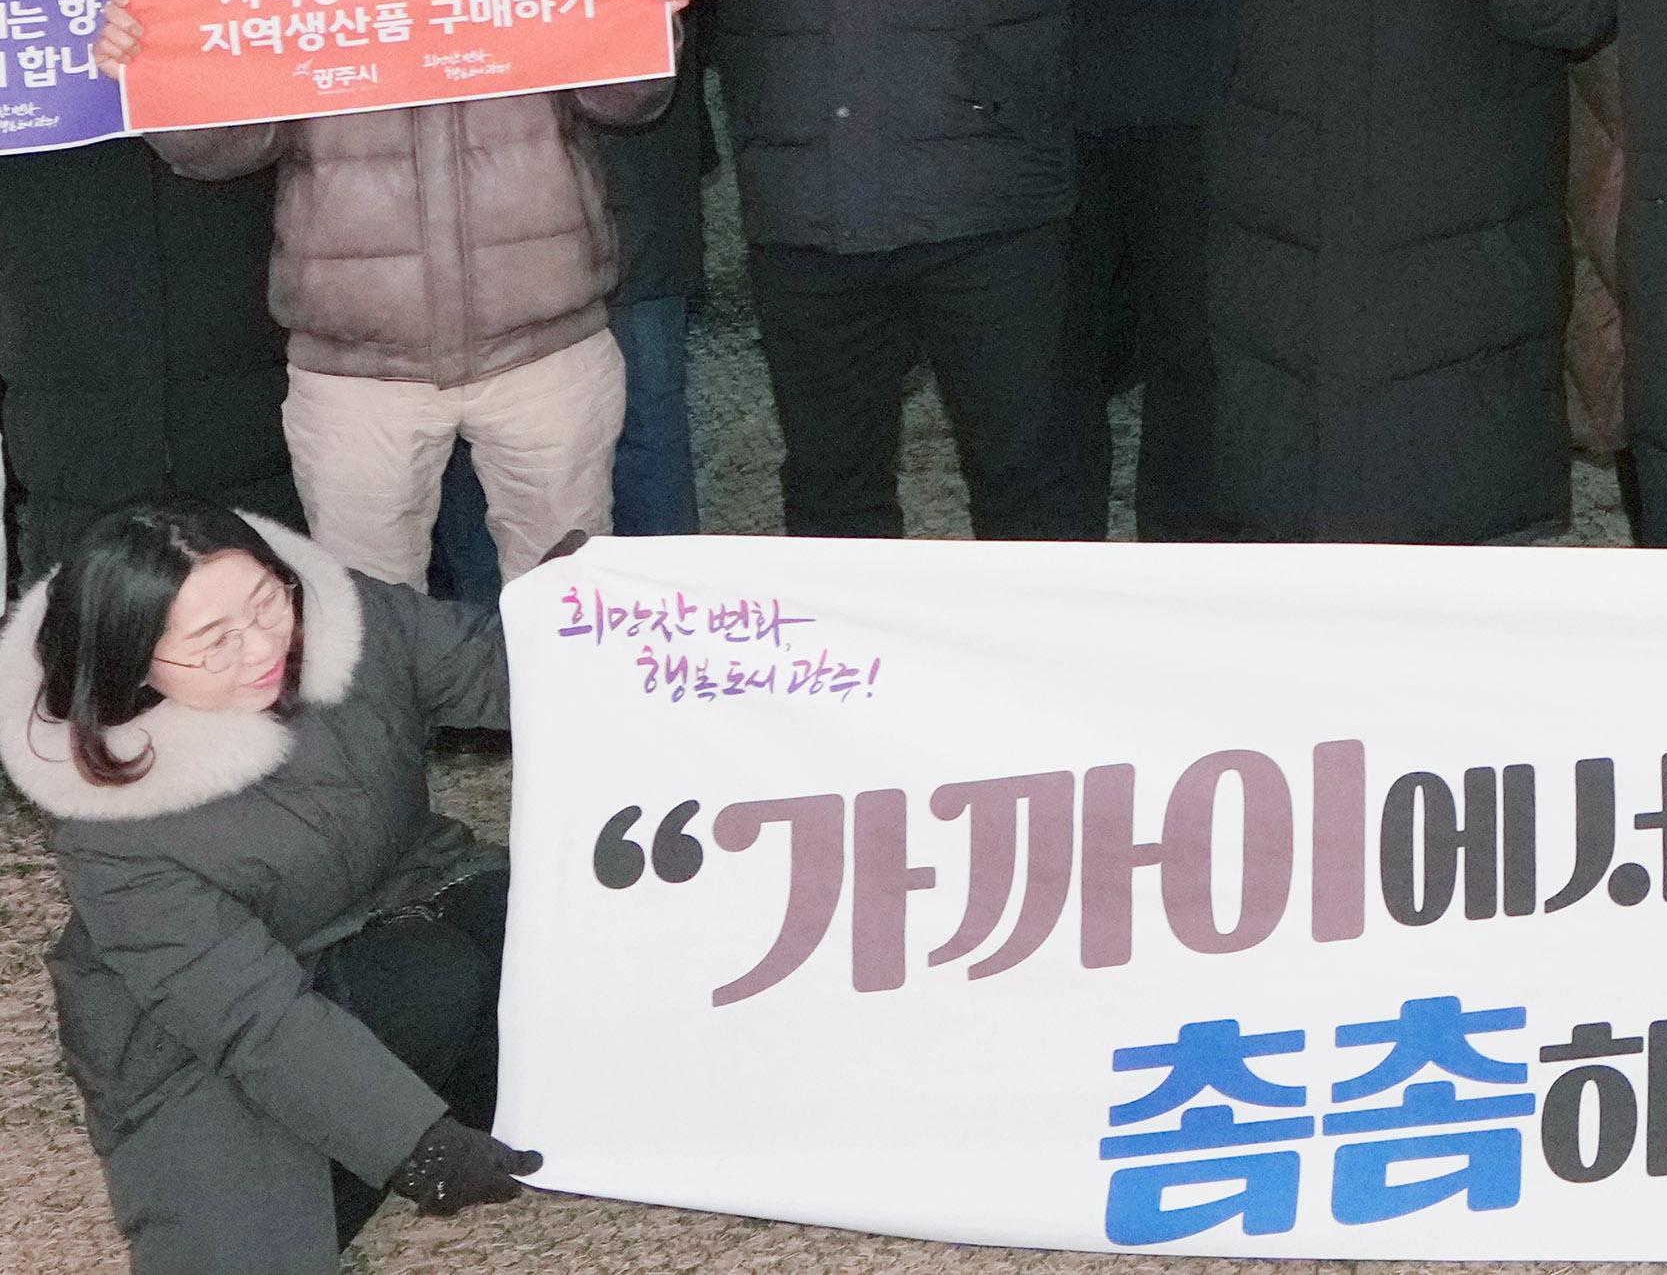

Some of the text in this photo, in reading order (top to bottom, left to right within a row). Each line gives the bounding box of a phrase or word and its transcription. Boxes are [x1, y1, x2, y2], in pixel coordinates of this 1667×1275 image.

[200, 0, 416, 56] 지역생산품
[311, 64, 378, 93] 광주시
[557, 586, 695, 647] 희망찬
[787, 656, 882, 701] 광주!
